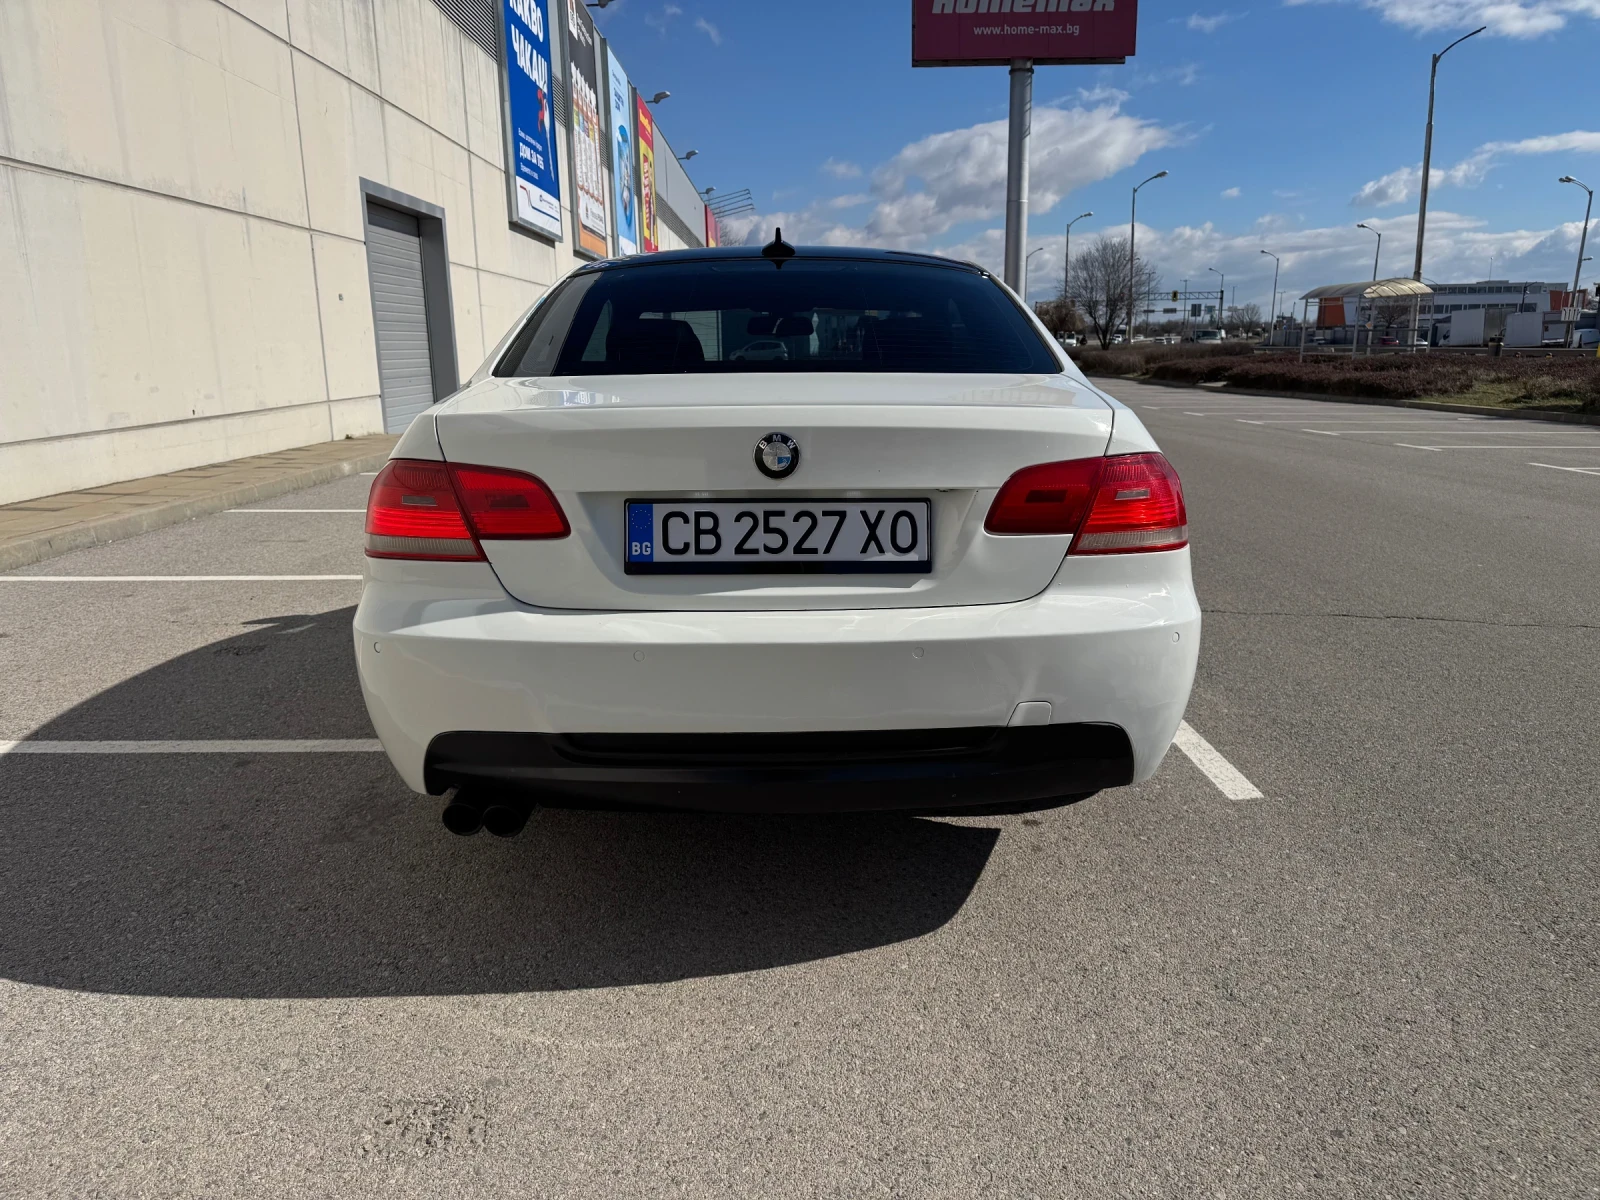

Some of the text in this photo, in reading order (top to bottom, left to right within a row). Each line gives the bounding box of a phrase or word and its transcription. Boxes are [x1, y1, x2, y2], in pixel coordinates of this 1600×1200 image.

[973, 24, 1080, 36] www.home-max.bg
[758, 434, 796, 449] BMW
[661, 510, 722, 555] CB
[733, 510, 847, 554] 2527
[631, 542, 652, 555] BG
